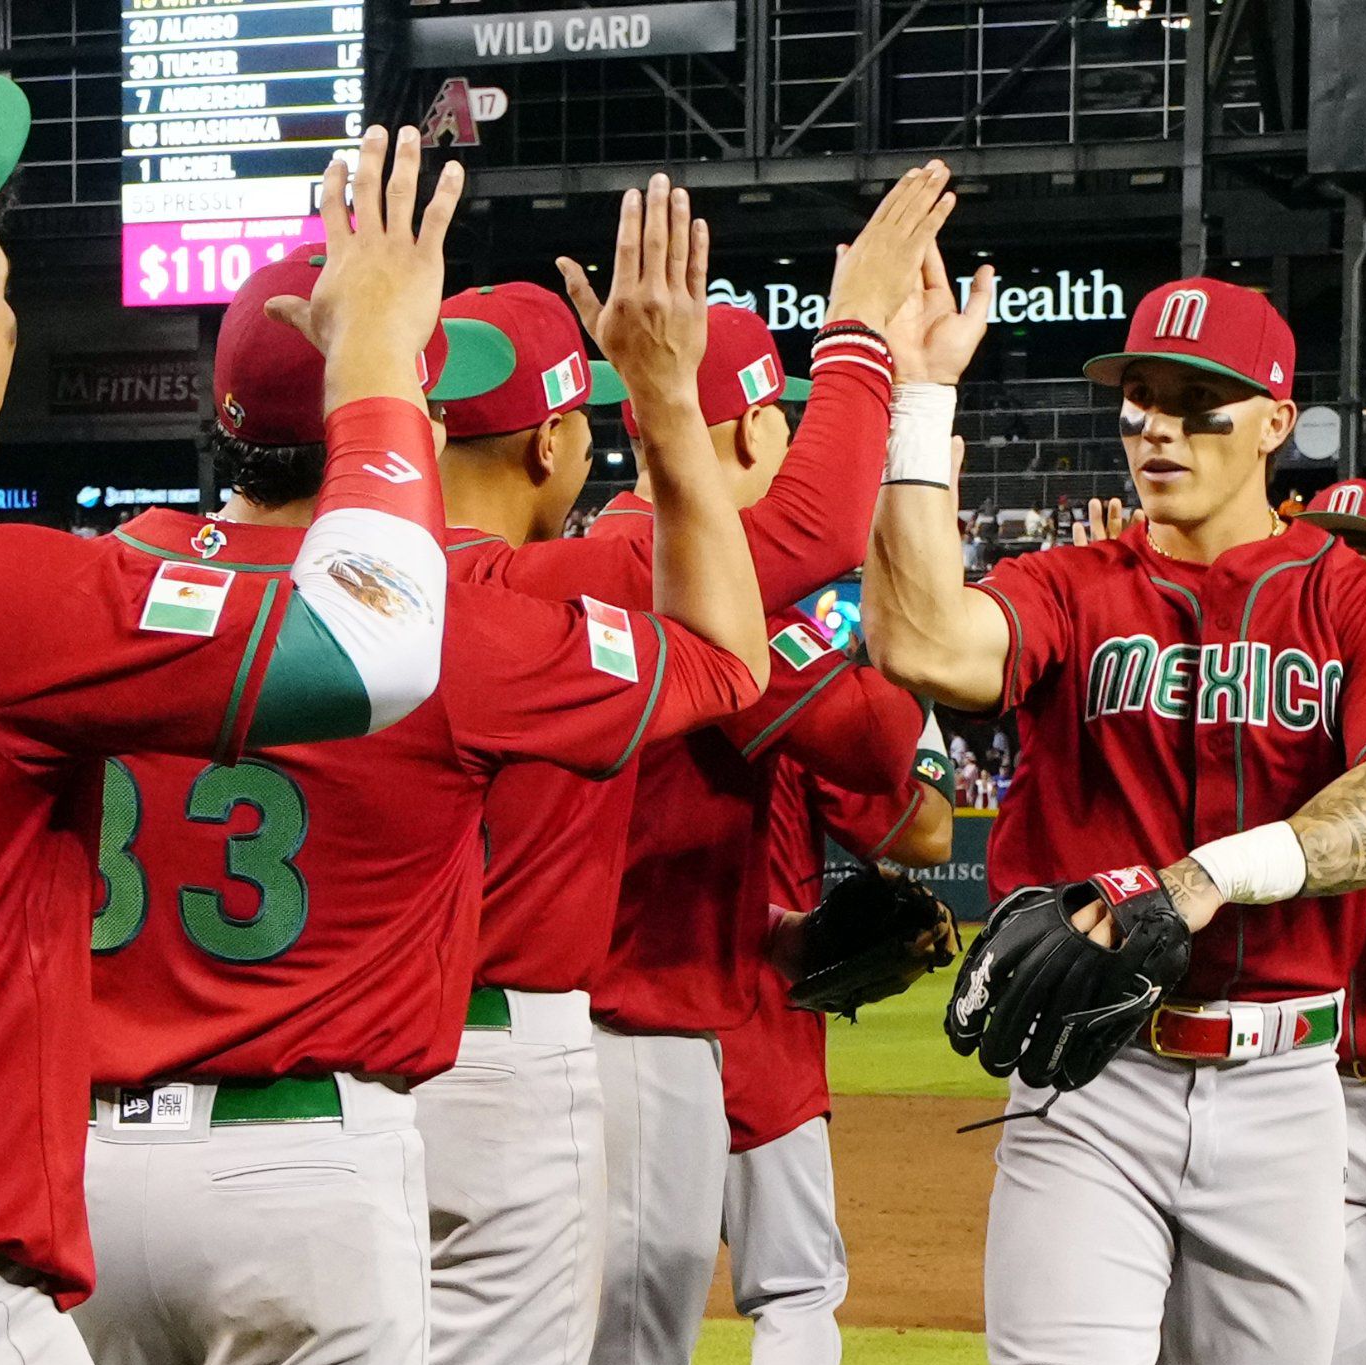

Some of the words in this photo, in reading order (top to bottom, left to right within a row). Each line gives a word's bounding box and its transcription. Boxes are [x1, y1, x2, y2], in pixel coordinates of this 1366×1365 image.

[129, 19, 158, 44] 20
[159, 13, 239, 42] ALONSO
[473, 19, 555, 57] WILD
[564, 14, 651, 52] CARD
[159, 50, 239, 78] TUCKER
[336, 43, 363, 69] LF
[135, 88, 152, 114] 7
[159, 82, 267, 113] ANDERSON
[333, 78, 363, 104] SS
[478, 94, 496, 117] 17
[345, 112, 362, 137] C
[139, 158, 150, 183] 1
[162, 191, 245, 212] PRESSLY
[156, 1105, 181, 1116] ERA
[157, 1094, 182, 1105] NEW
